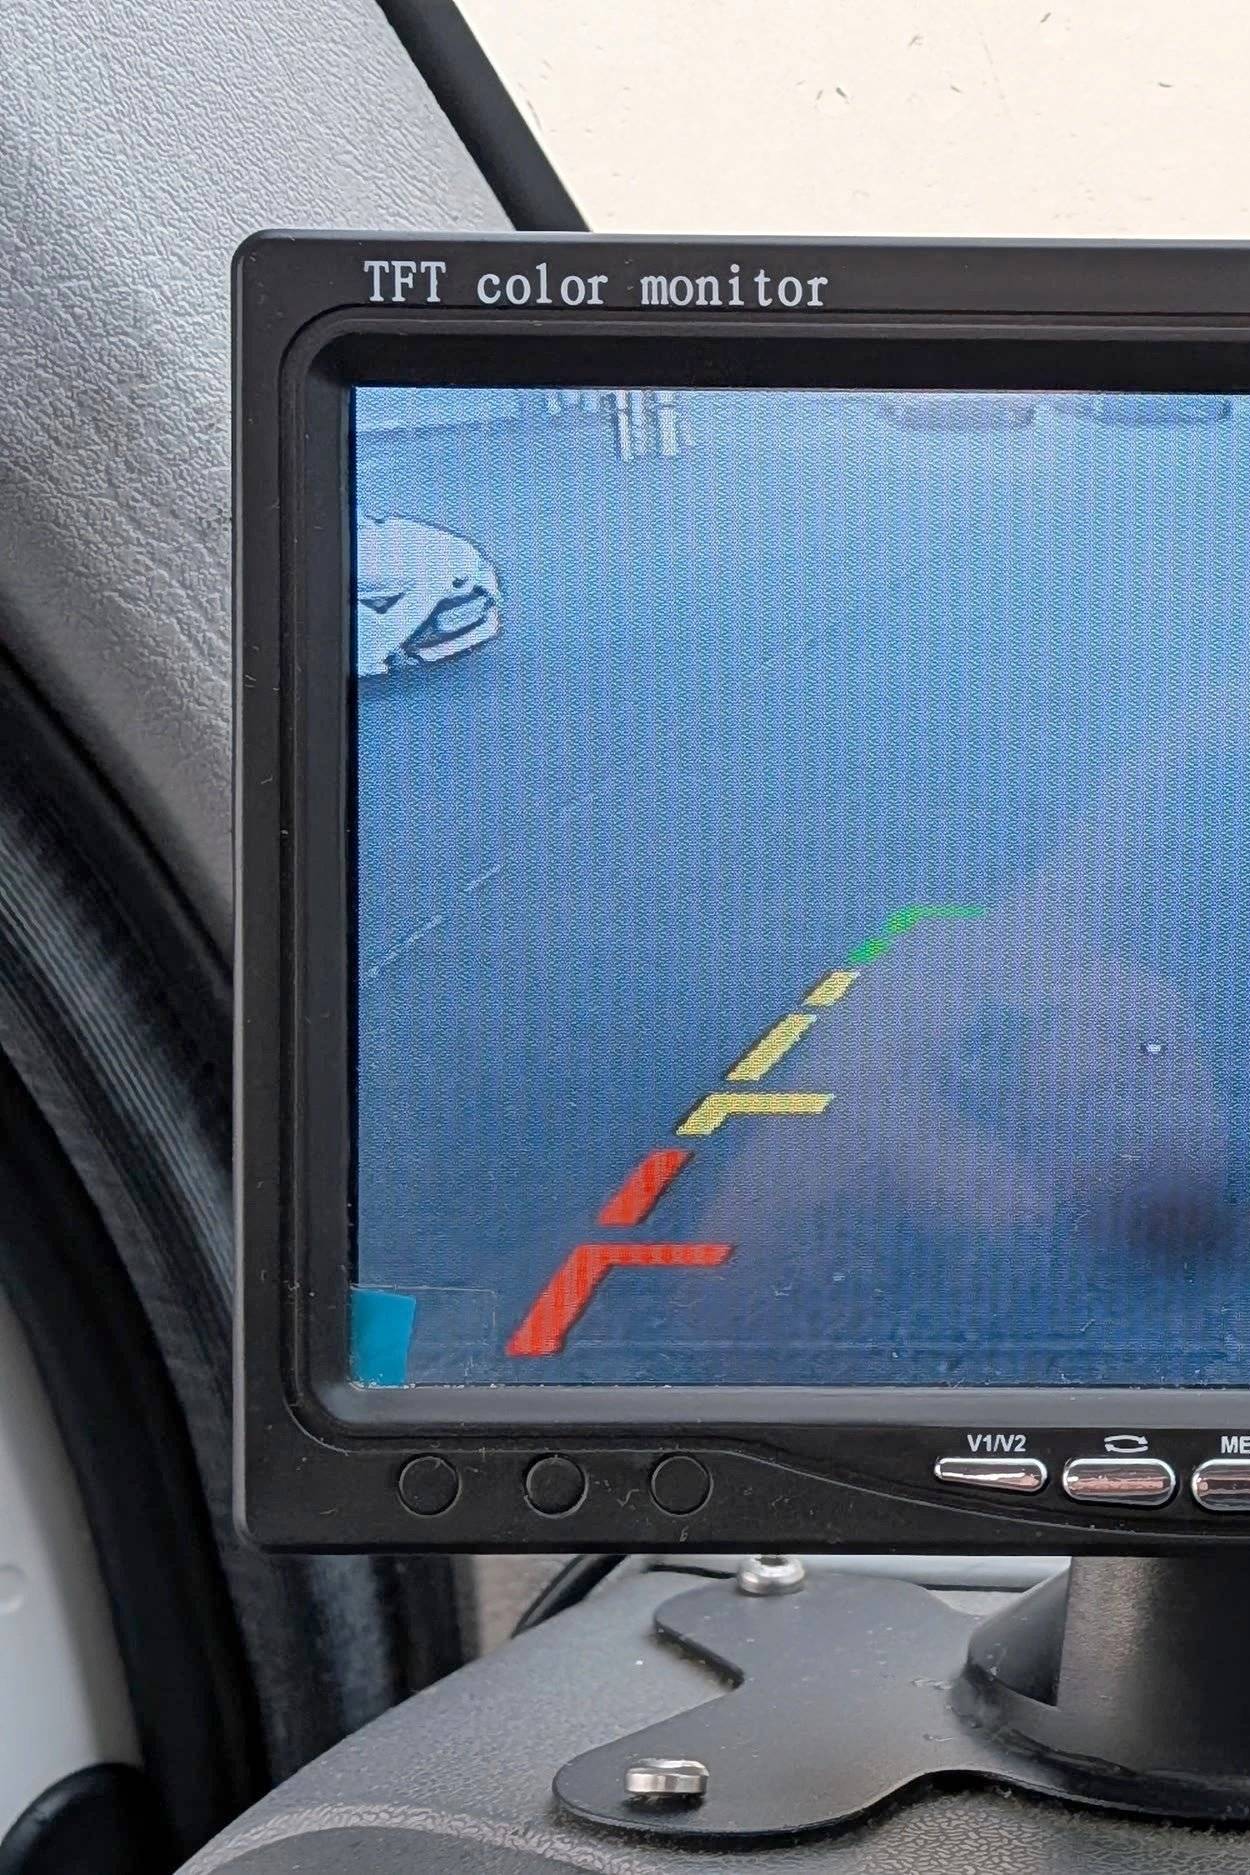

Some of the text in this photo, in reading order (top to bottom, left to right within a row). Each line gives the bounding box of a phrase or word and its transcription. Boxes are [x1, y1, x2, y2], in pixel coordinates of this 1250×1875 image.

[363, 260, 829, 307] TFT color monitor
[966, 1434, 1027, 1454] V1/V2
